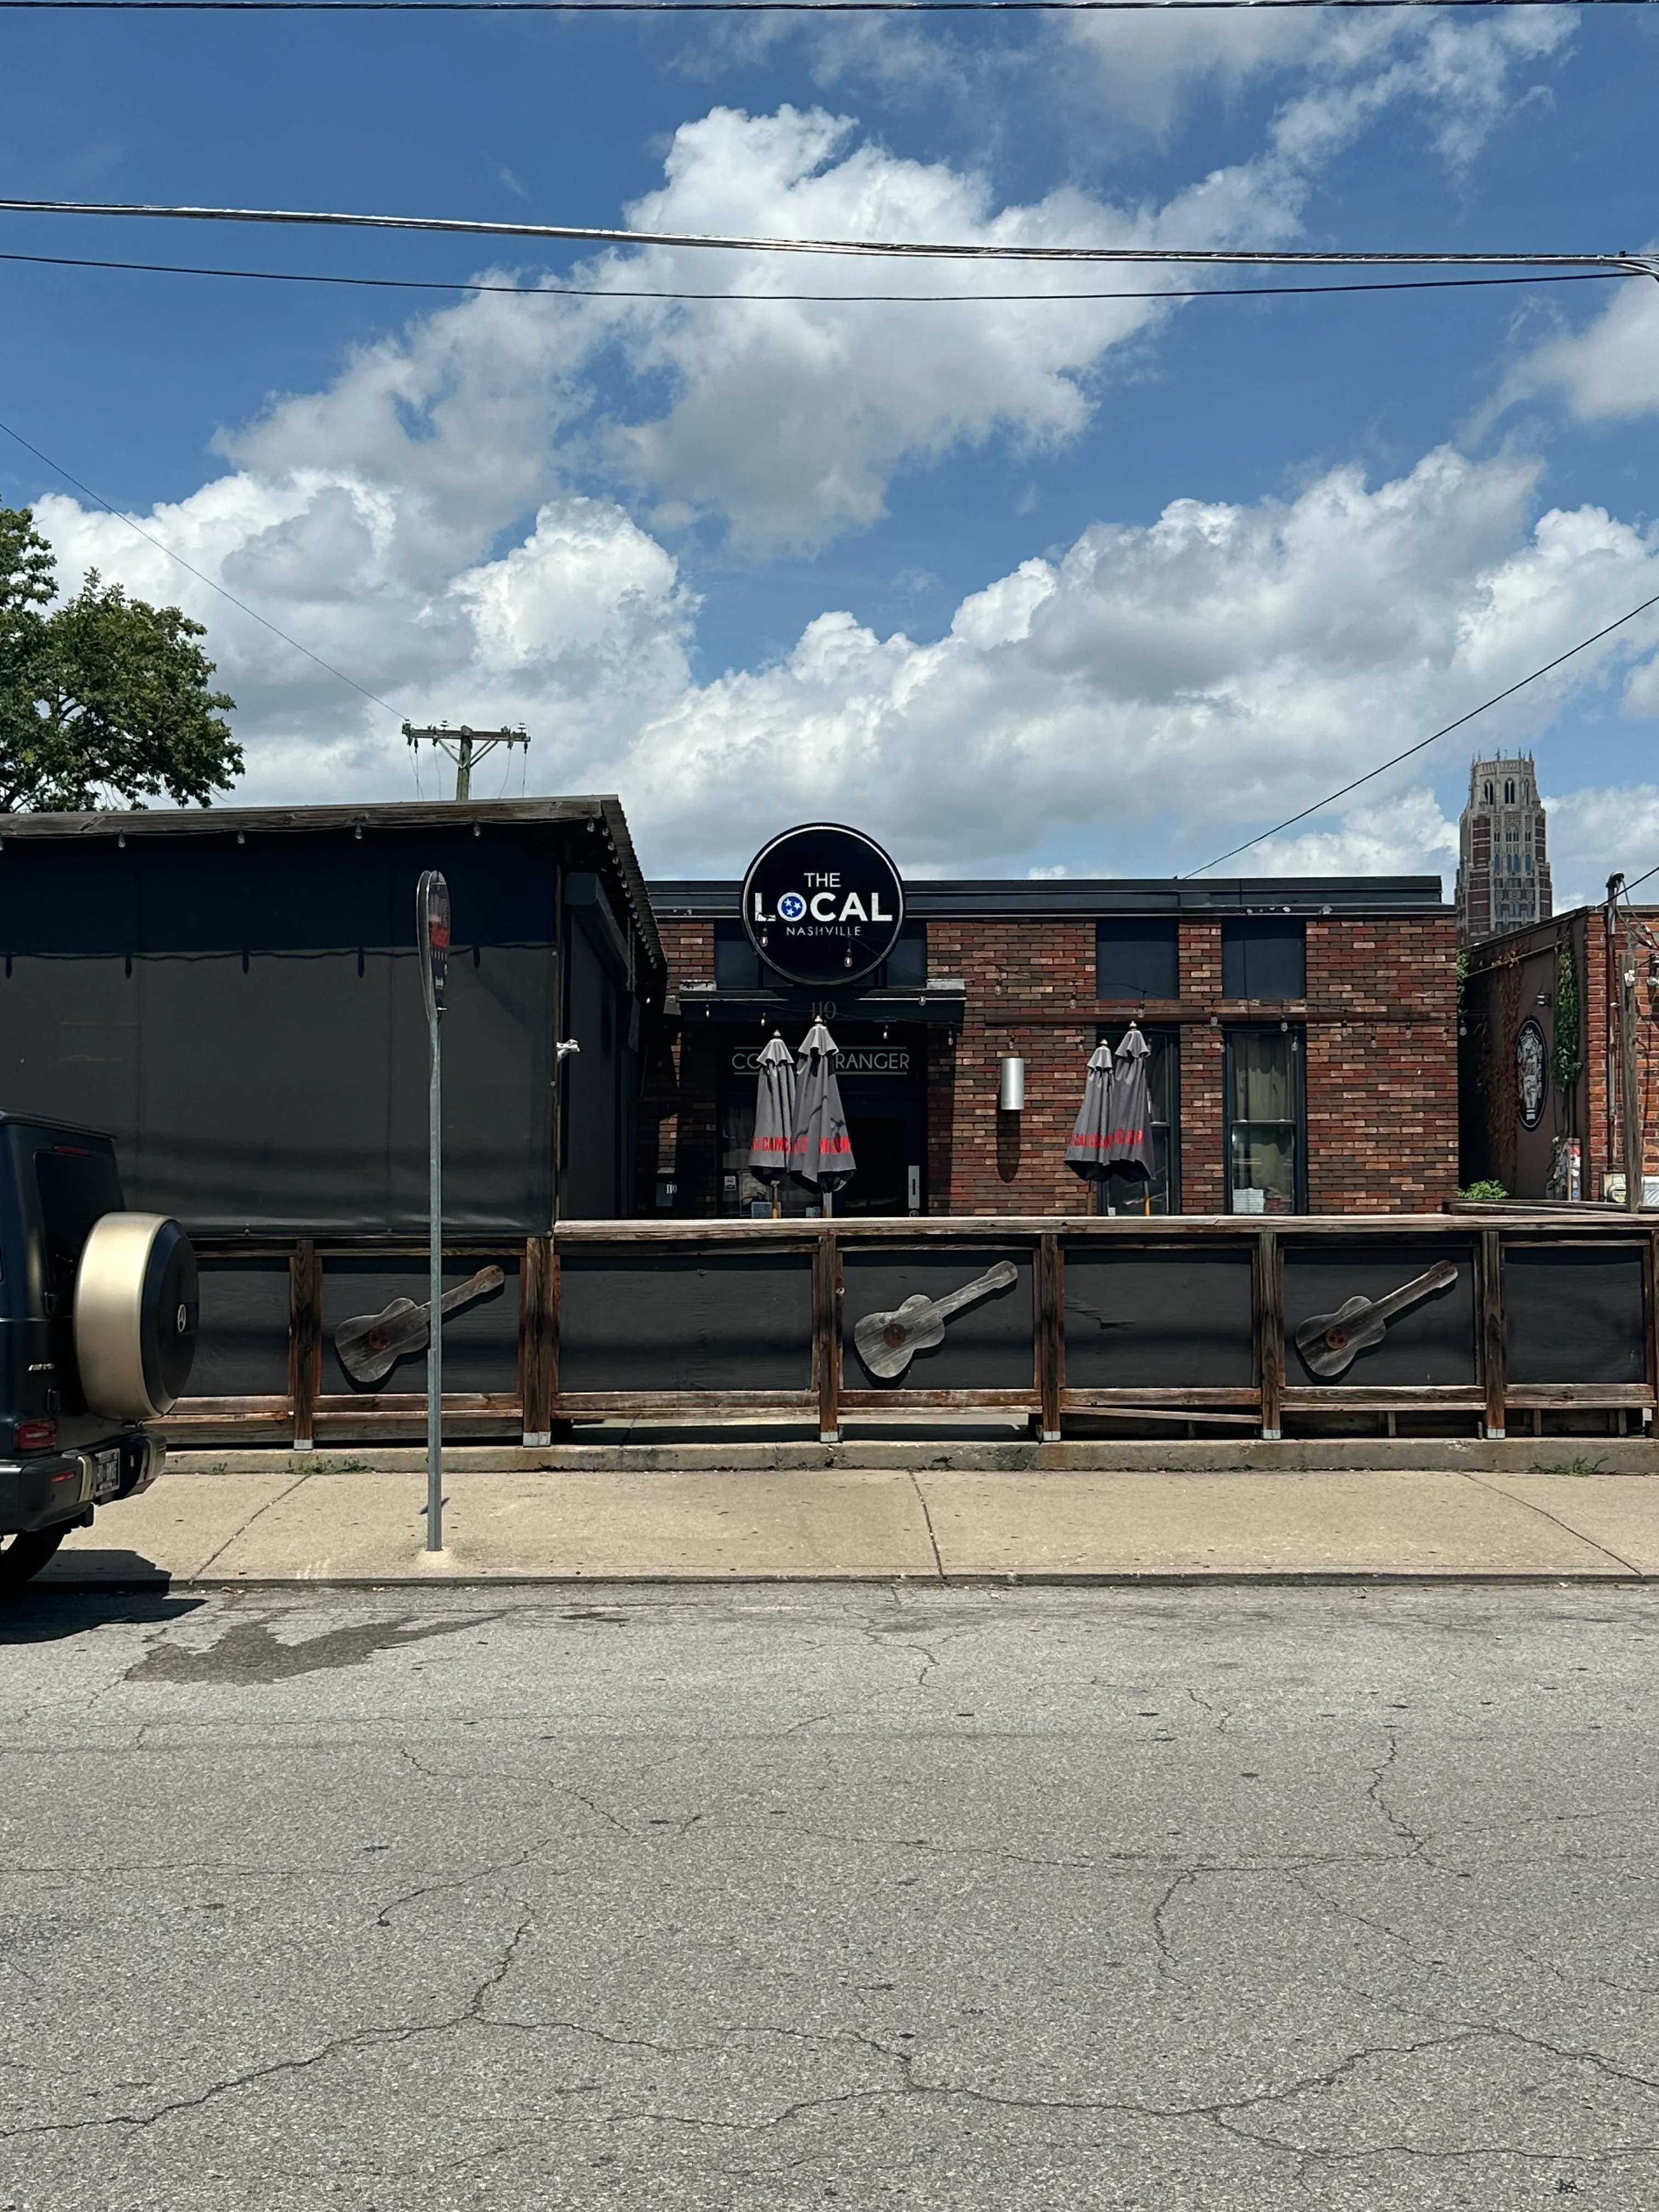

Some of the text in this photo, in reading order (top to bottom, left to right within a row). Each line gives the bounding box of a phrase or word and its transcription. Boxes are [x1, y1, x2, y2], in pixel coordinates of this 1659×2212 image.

[804, 872, 841, 887] THE
[754, 891, 893, 922] LOCAL
[786, 926, 862, 936] NASHVILLE
[809, 1000, 837, 1020] 110
[835, 1053, 910, 1069] RANGER
